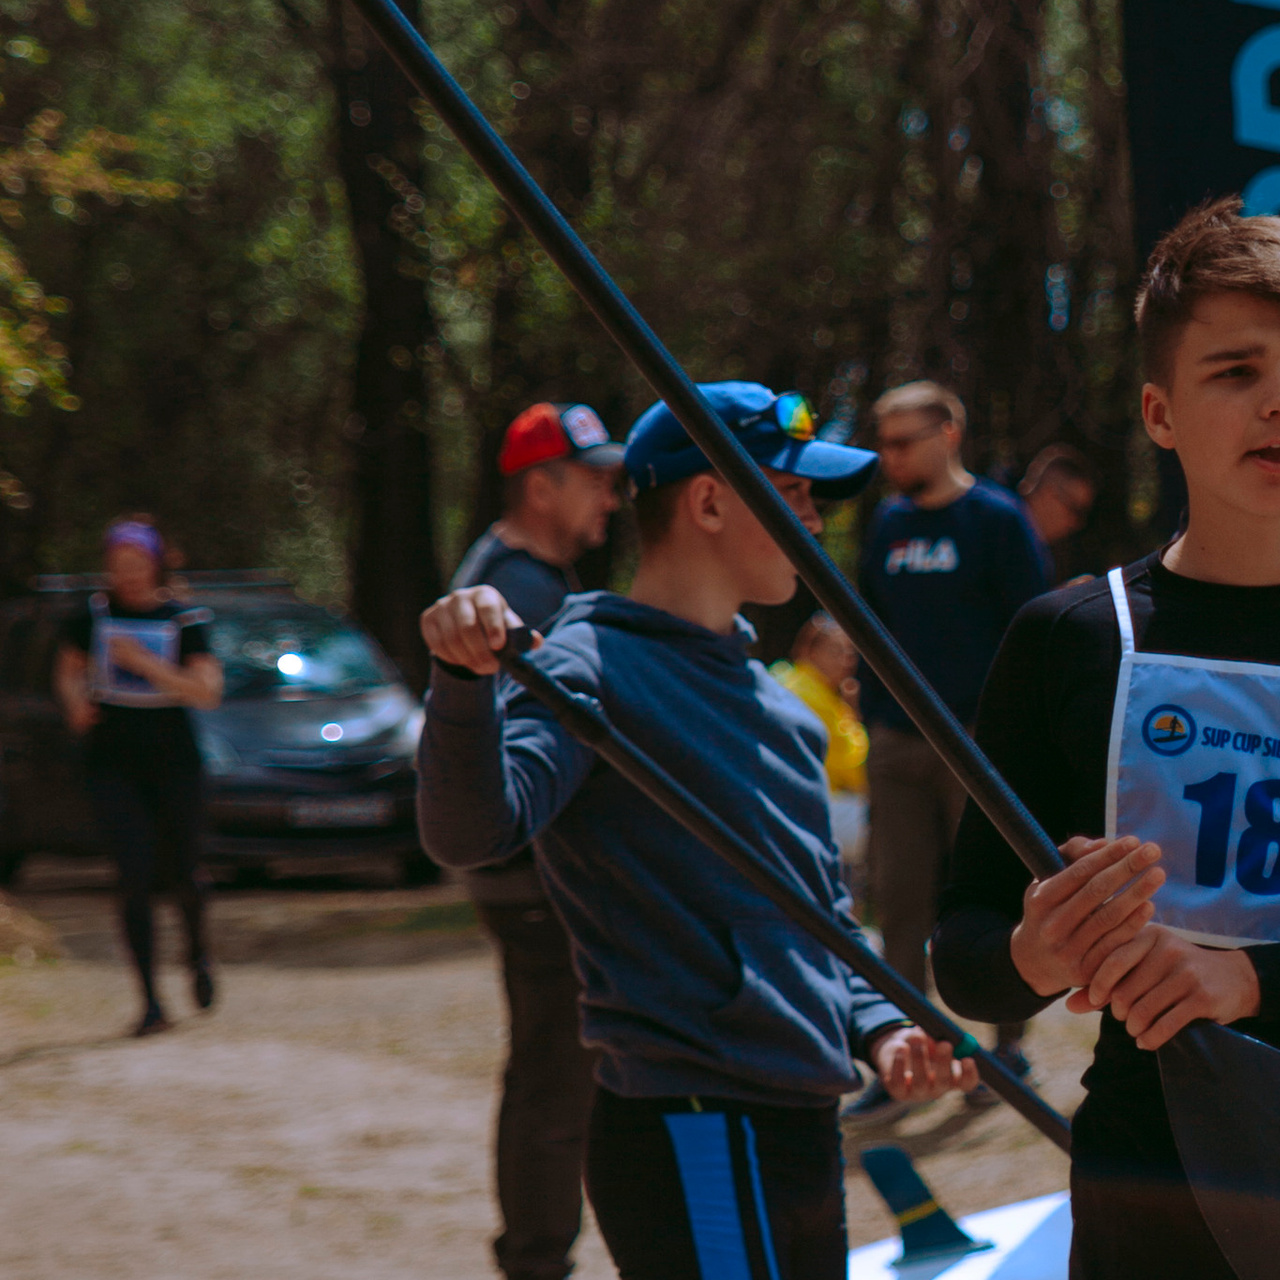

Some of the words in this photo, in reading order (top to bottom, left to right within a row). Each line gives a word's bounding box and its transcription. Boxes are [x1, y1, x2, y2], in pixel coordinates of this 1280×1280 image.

[886, 537, 958, 575] FILA
[1201, 726, 1231, 748] SUP
[1232, 731, 1262, 754] CUP
